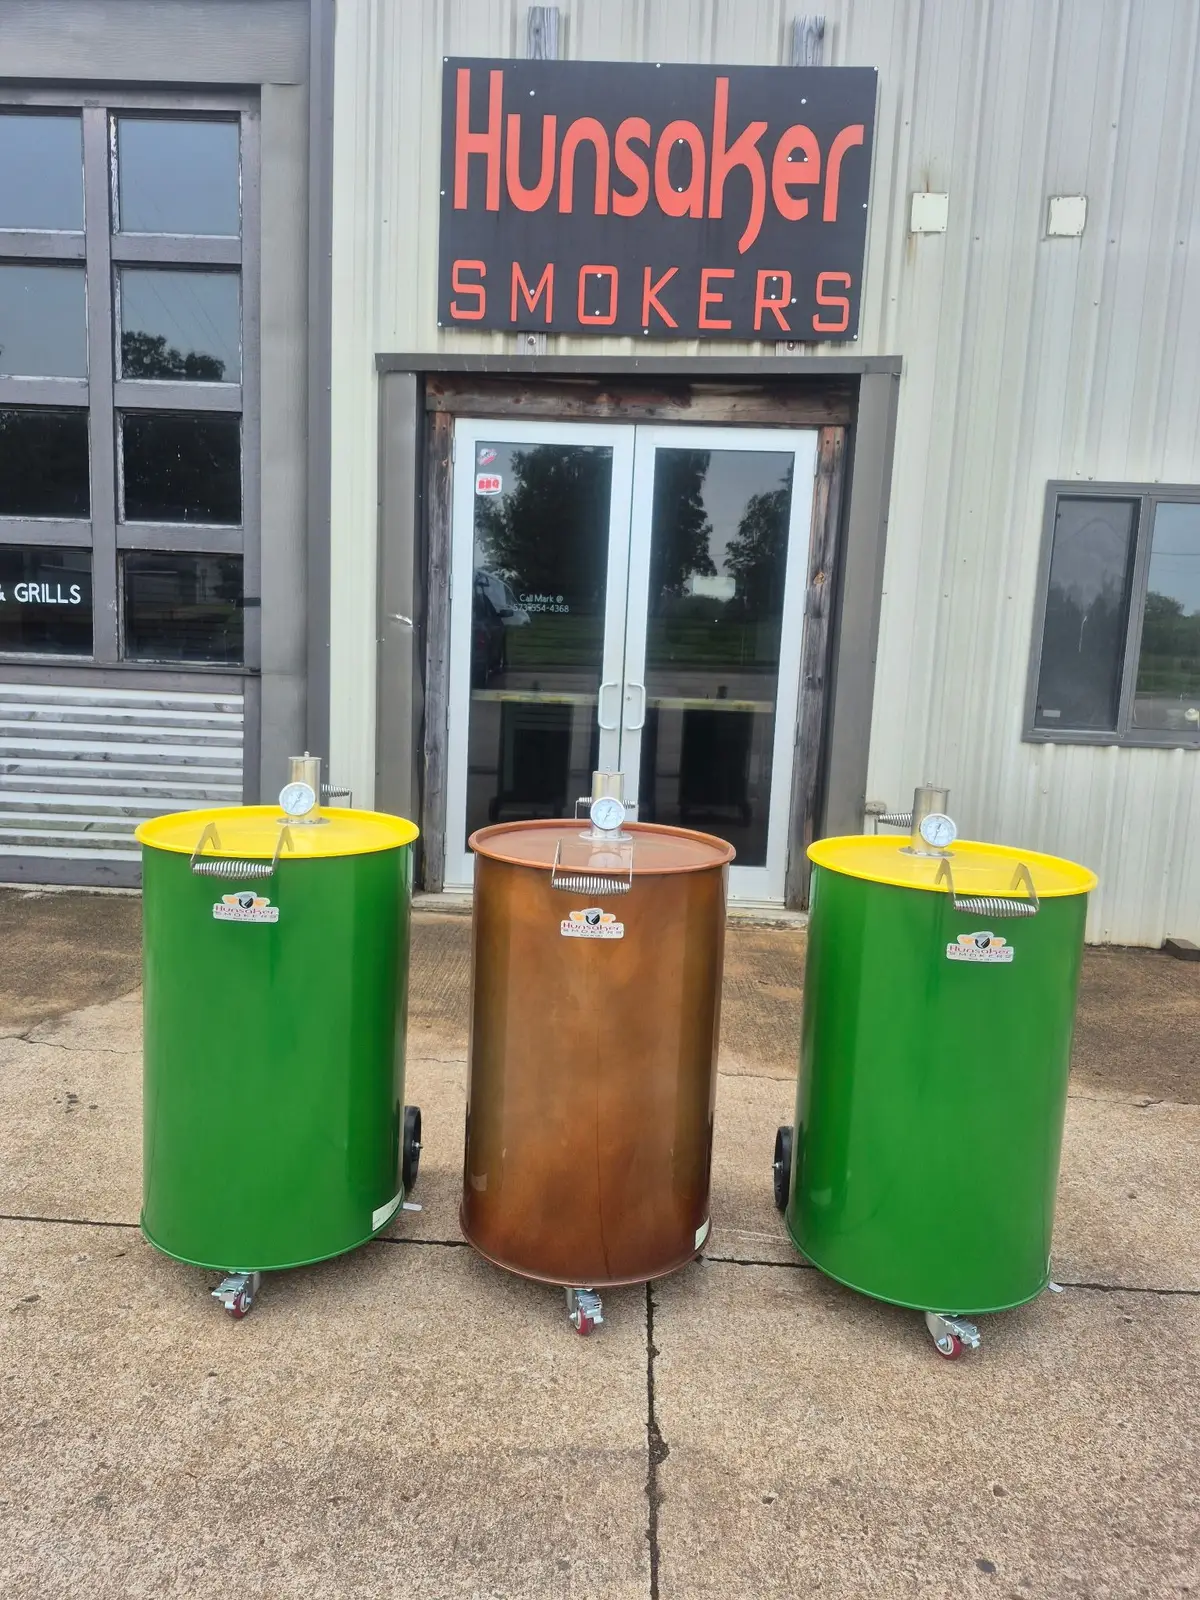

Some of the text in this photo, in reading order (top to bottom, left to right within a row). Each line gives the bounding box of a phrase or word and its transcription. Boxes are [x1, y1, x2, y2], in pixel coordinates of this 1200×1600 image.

[454, 68, 865, 254] Hunsaker
[450, 259, 852, 332] SMOKERS
[14, 582, 81, 604] GRILLS
[519, 593, 534, 602] Call
[534, 593, 554, 603] Mark
